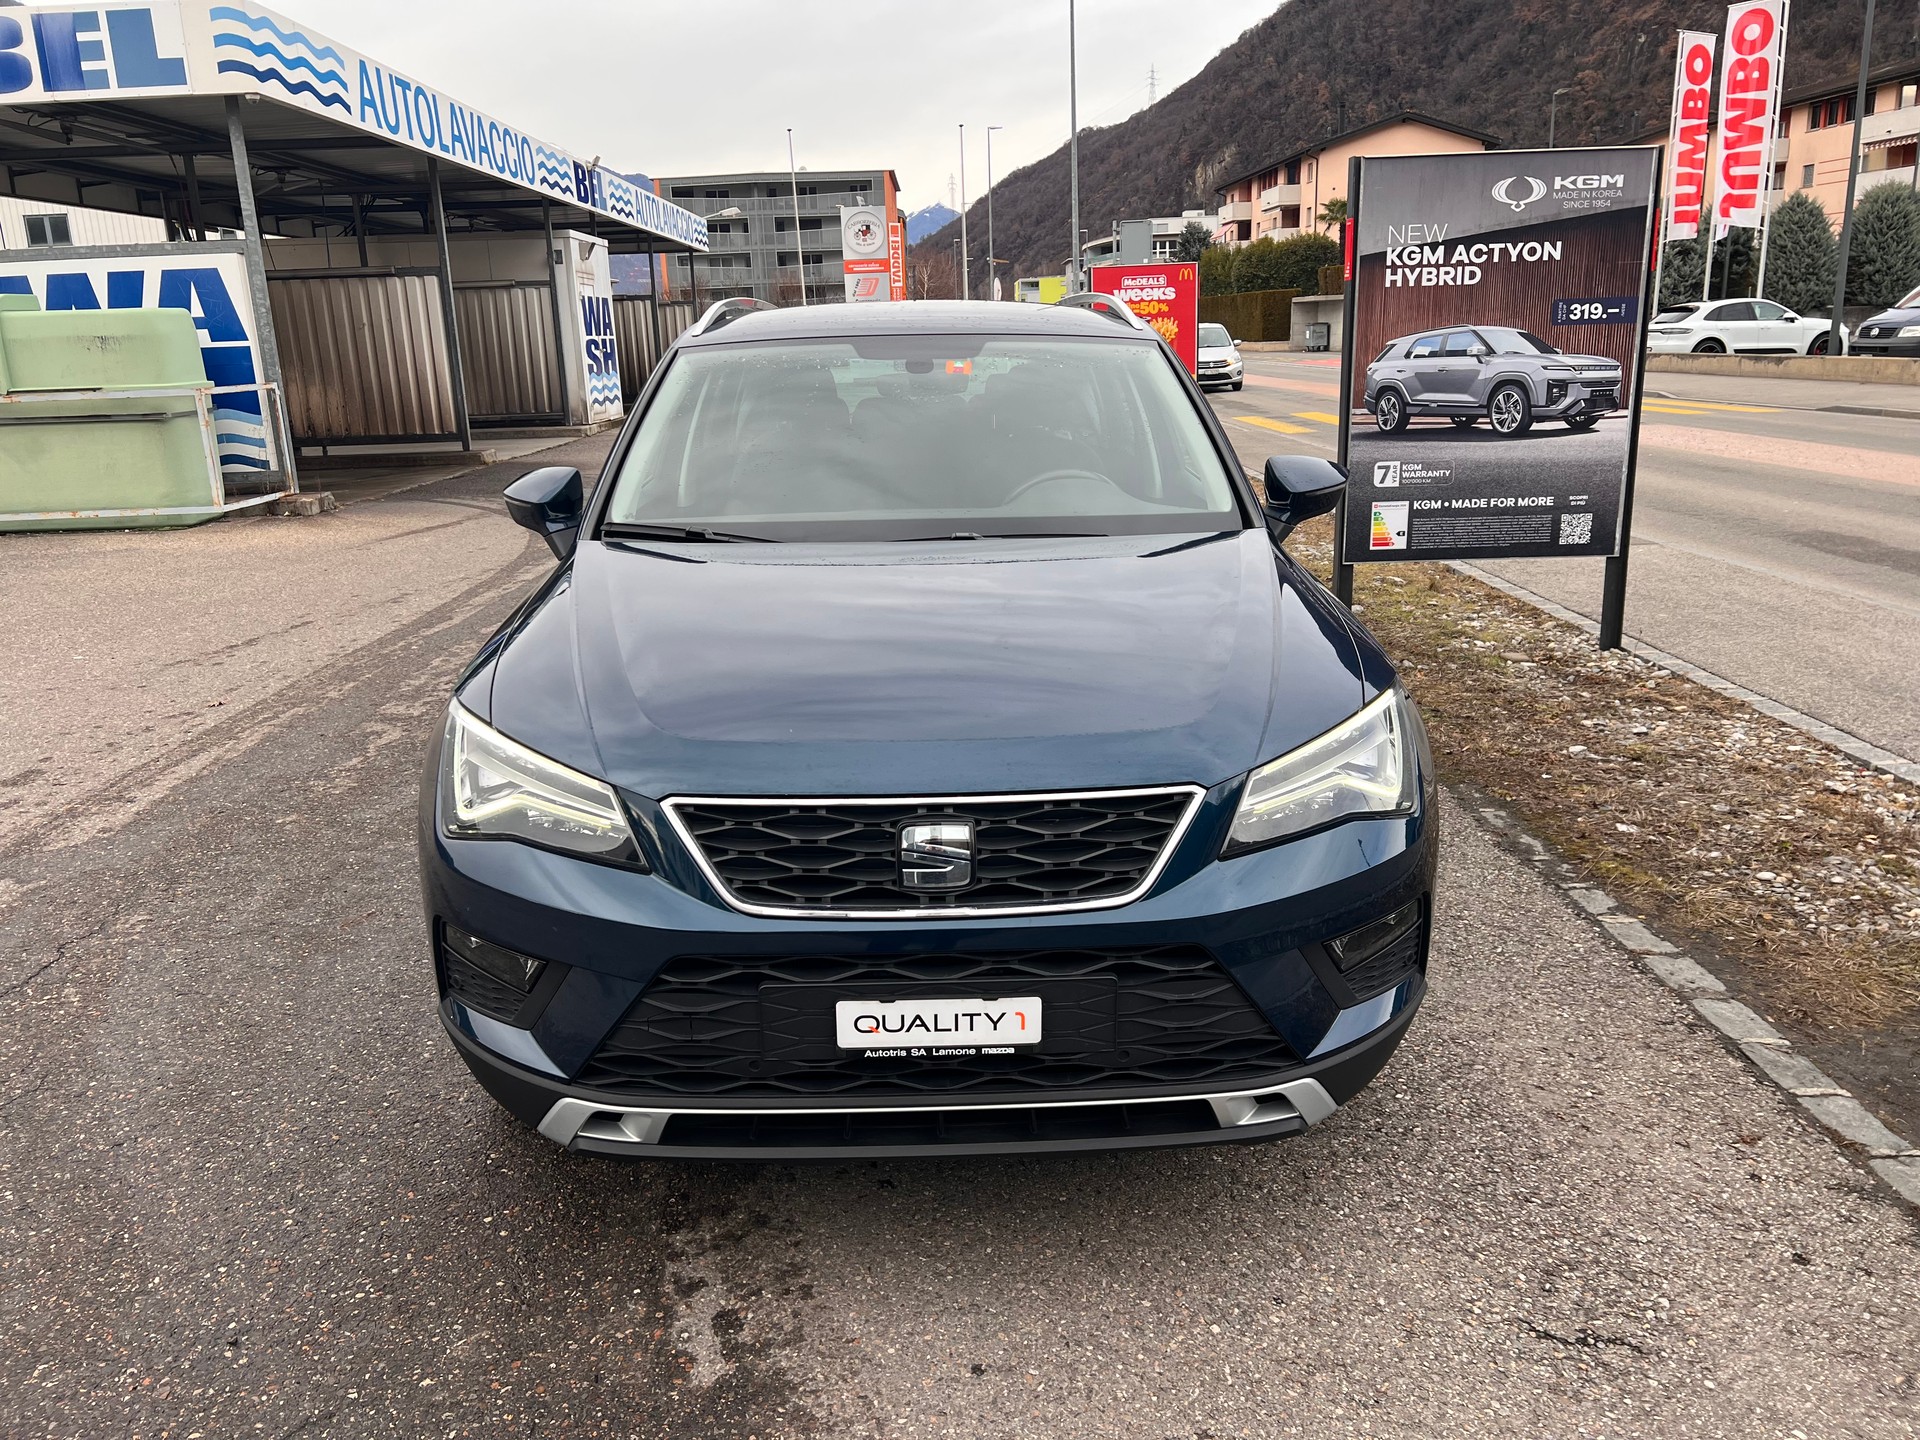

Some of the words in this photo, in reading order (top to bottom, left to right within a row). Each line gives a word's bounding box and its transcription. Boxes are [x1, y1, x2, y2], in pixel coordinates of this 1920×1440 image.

[1718, 8, 1774, 218] JUMBO
[358, 59, 536, 186] AUTOLAVACCIO
[572, 159, 608, 212] BEL
[1673, 43, 1713, 235] JUMBO
[1554, 174, 1625, 190] KGM
[1553, 191, 1579, 199] MADE
[1592, 190, 1623, 198] KOREA
[1563, 200, 1590, 209] SINCE
[1592, 200, 1611, 208] 1954
[635, 189, 694, 244] AUTOLAVACCIO
[1388, 224, 1448, 244] NEW
[1386, 245, 1445, 266] KGM
[1450, 241, 1562, 264] ACTYON
[1124, 277, 1165, 286] McDEALS
[1385, 265, 1482, 287] HYBRID
[1377, 464, 1392, 485] 7
[1402, 463, 1422, 471] KGM
[1402, 470, 1451, 478] WARRANTY
[1413, 500, 1442, 510] KGM
[1451, 499, 1488, 508] MADE
[1490, 498, 1515, 507] FOR
[1517, 496, 1555, 506] MORE
[854, 1012, 1006, 1034] QUALITY
[1015, 1011, 1026, 1031] 1
[864, 1049, 907, 1058] Autotris
[911, 1048, 927, 1056] SA
[932, 1047, 976, 1056] Lamone
